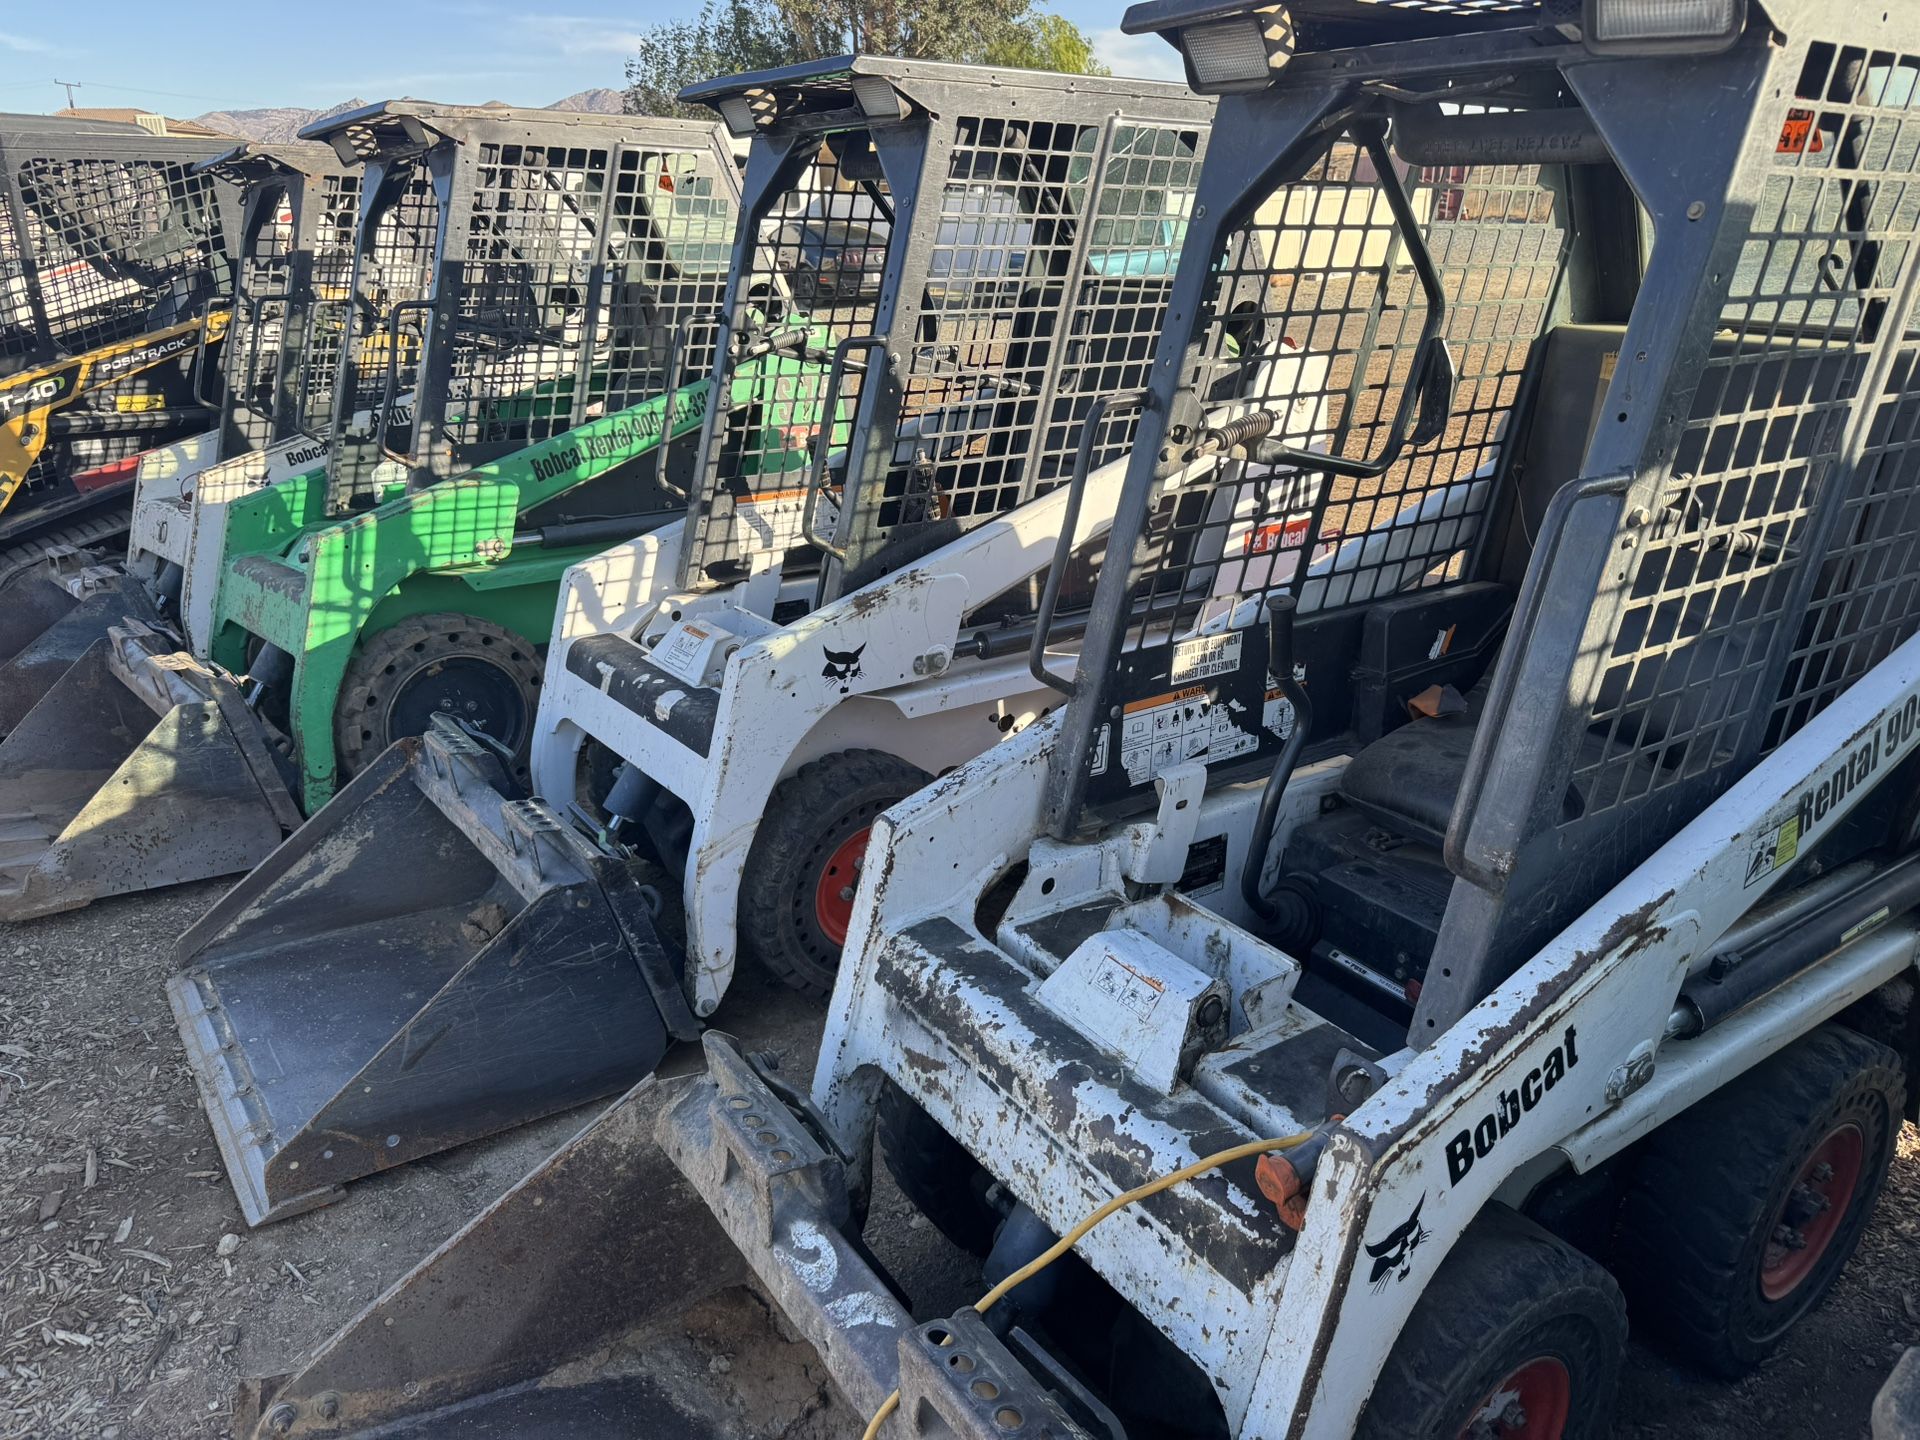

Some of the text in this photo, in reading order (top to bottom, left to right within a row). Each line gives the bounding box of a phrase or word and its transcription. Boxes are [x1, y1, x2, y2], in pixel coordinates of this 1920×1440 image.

[102, 340, 188, 373] POSI-TRACK
[286, 441, 329, 466] Bobca
[530, 442, 587, 482] Bobcat
[584, 421, 634, 461] Rental
[1174, 633, 1241, 658] RETURN THIS EQUIPMENT
[1190, 649, 1224, 667] CLEAN OR BE
[1174, 658, 1238, 683] CHARGED FOR CLEANING
[1799, 727, 1881, 839] Rental
[1350, 963, 1368, 975] PUSH
[1445, 1024, 1579, 1188] Bobcat
